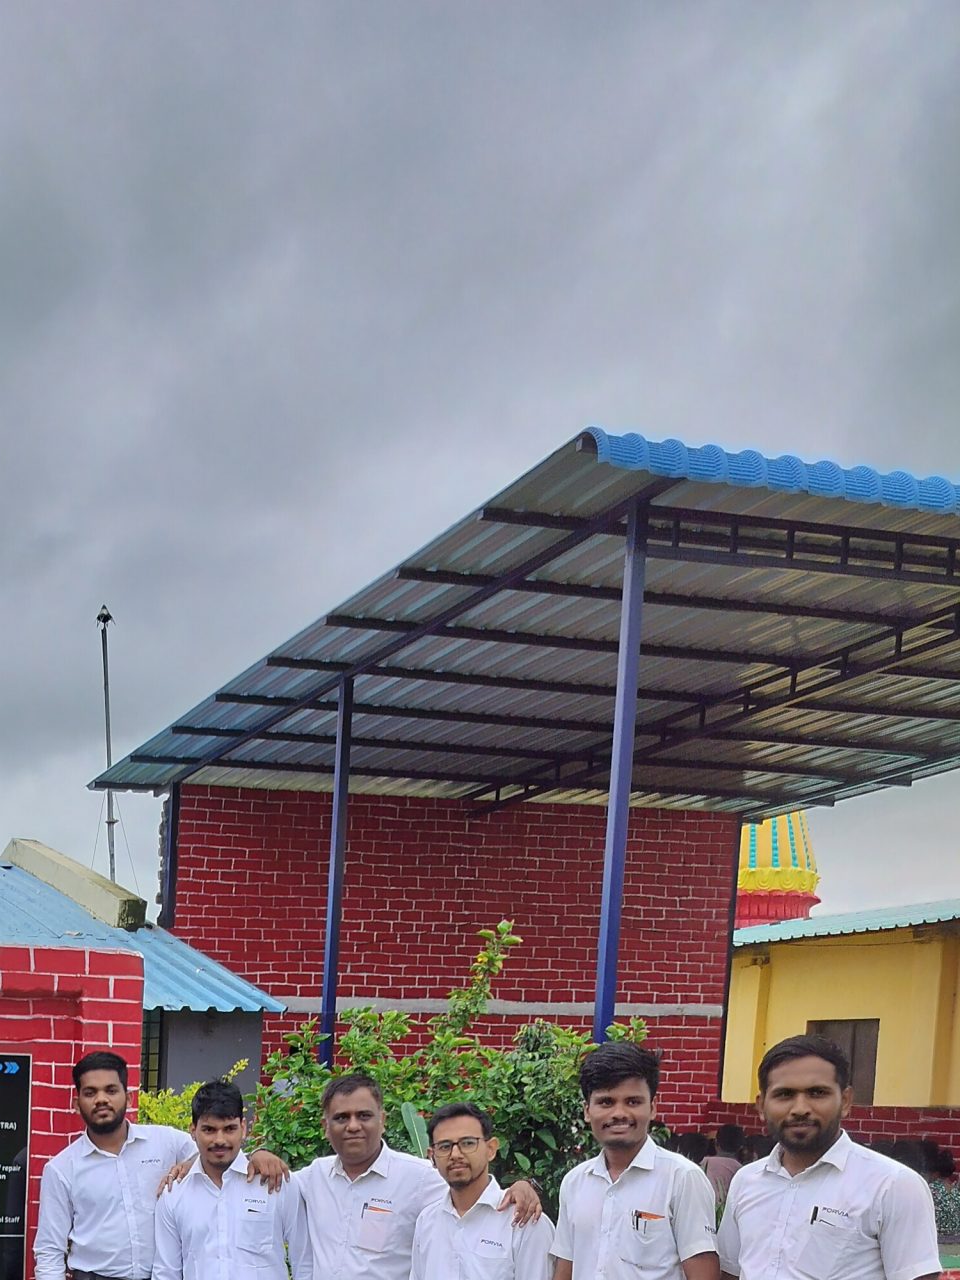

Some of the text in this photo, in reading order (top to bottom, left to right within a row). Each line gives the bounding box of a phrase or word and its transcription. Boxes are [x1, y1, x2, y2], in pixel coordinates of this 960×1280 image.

[2, 1165, 21, 1174] repair
[370, 1197, 393, 1205] FORVIA
[822, 1206, 849, 1218] FORVIA
[5, 1216, 20, 1224] Staff
[480, 1239, 503, 1248] FORVIA
